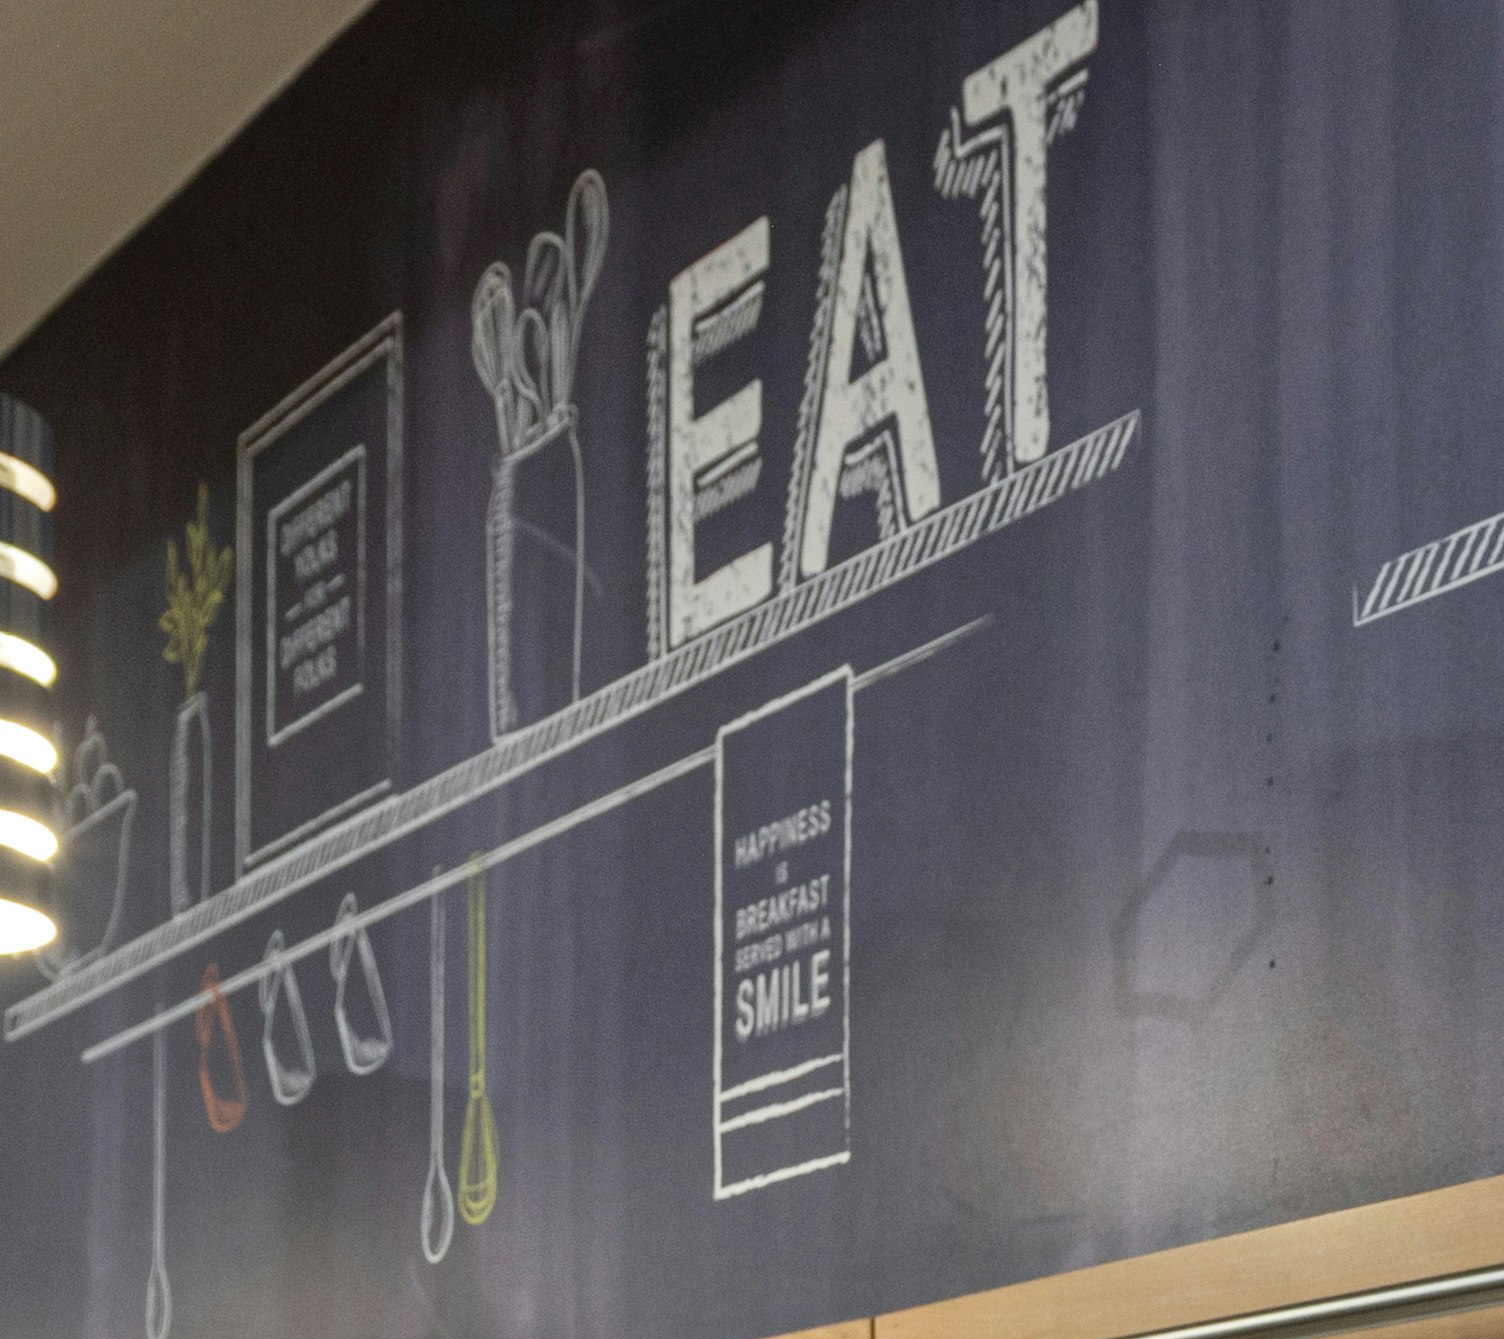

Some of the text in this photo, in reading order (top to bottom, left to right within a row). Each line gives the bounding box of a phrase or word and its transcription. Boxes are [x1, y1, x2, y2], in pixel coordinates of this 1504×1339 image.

[646, 0, 1100, 662] EAT
[734, 799, 831, 869] HAPPINESS
[735, 873, 831, 942] BREAKFAST
[735, 933, 783, 973] SERVED
[820, 914, 832, 941] A
[735, 949, 831, 1042] SMILE
